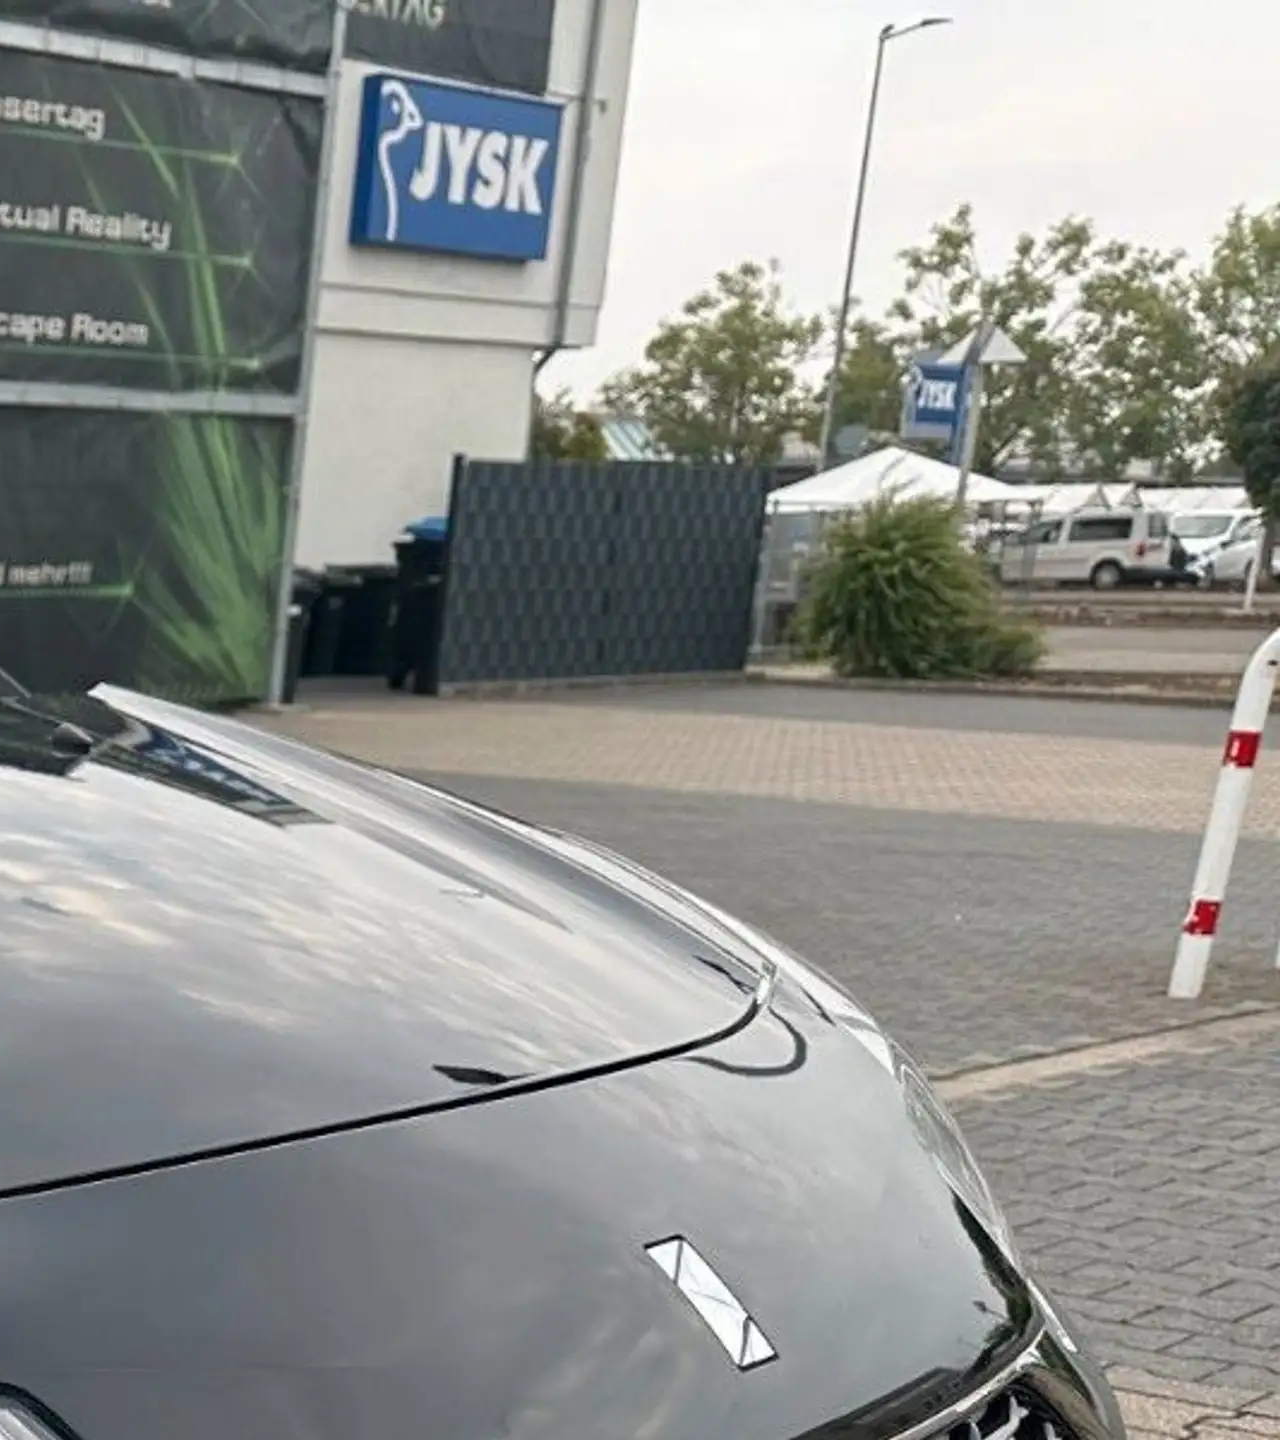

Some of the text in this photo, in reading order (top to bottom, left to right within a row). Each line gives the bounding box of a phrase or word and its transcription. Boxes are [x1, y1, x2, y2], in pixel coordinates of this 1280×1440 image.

[408, 120, 550, 216] JYSK
[65, 206, 172, 252] Reality
[70, 312, 149, 346] Room
[917, 379, 957, 411] JYSK
